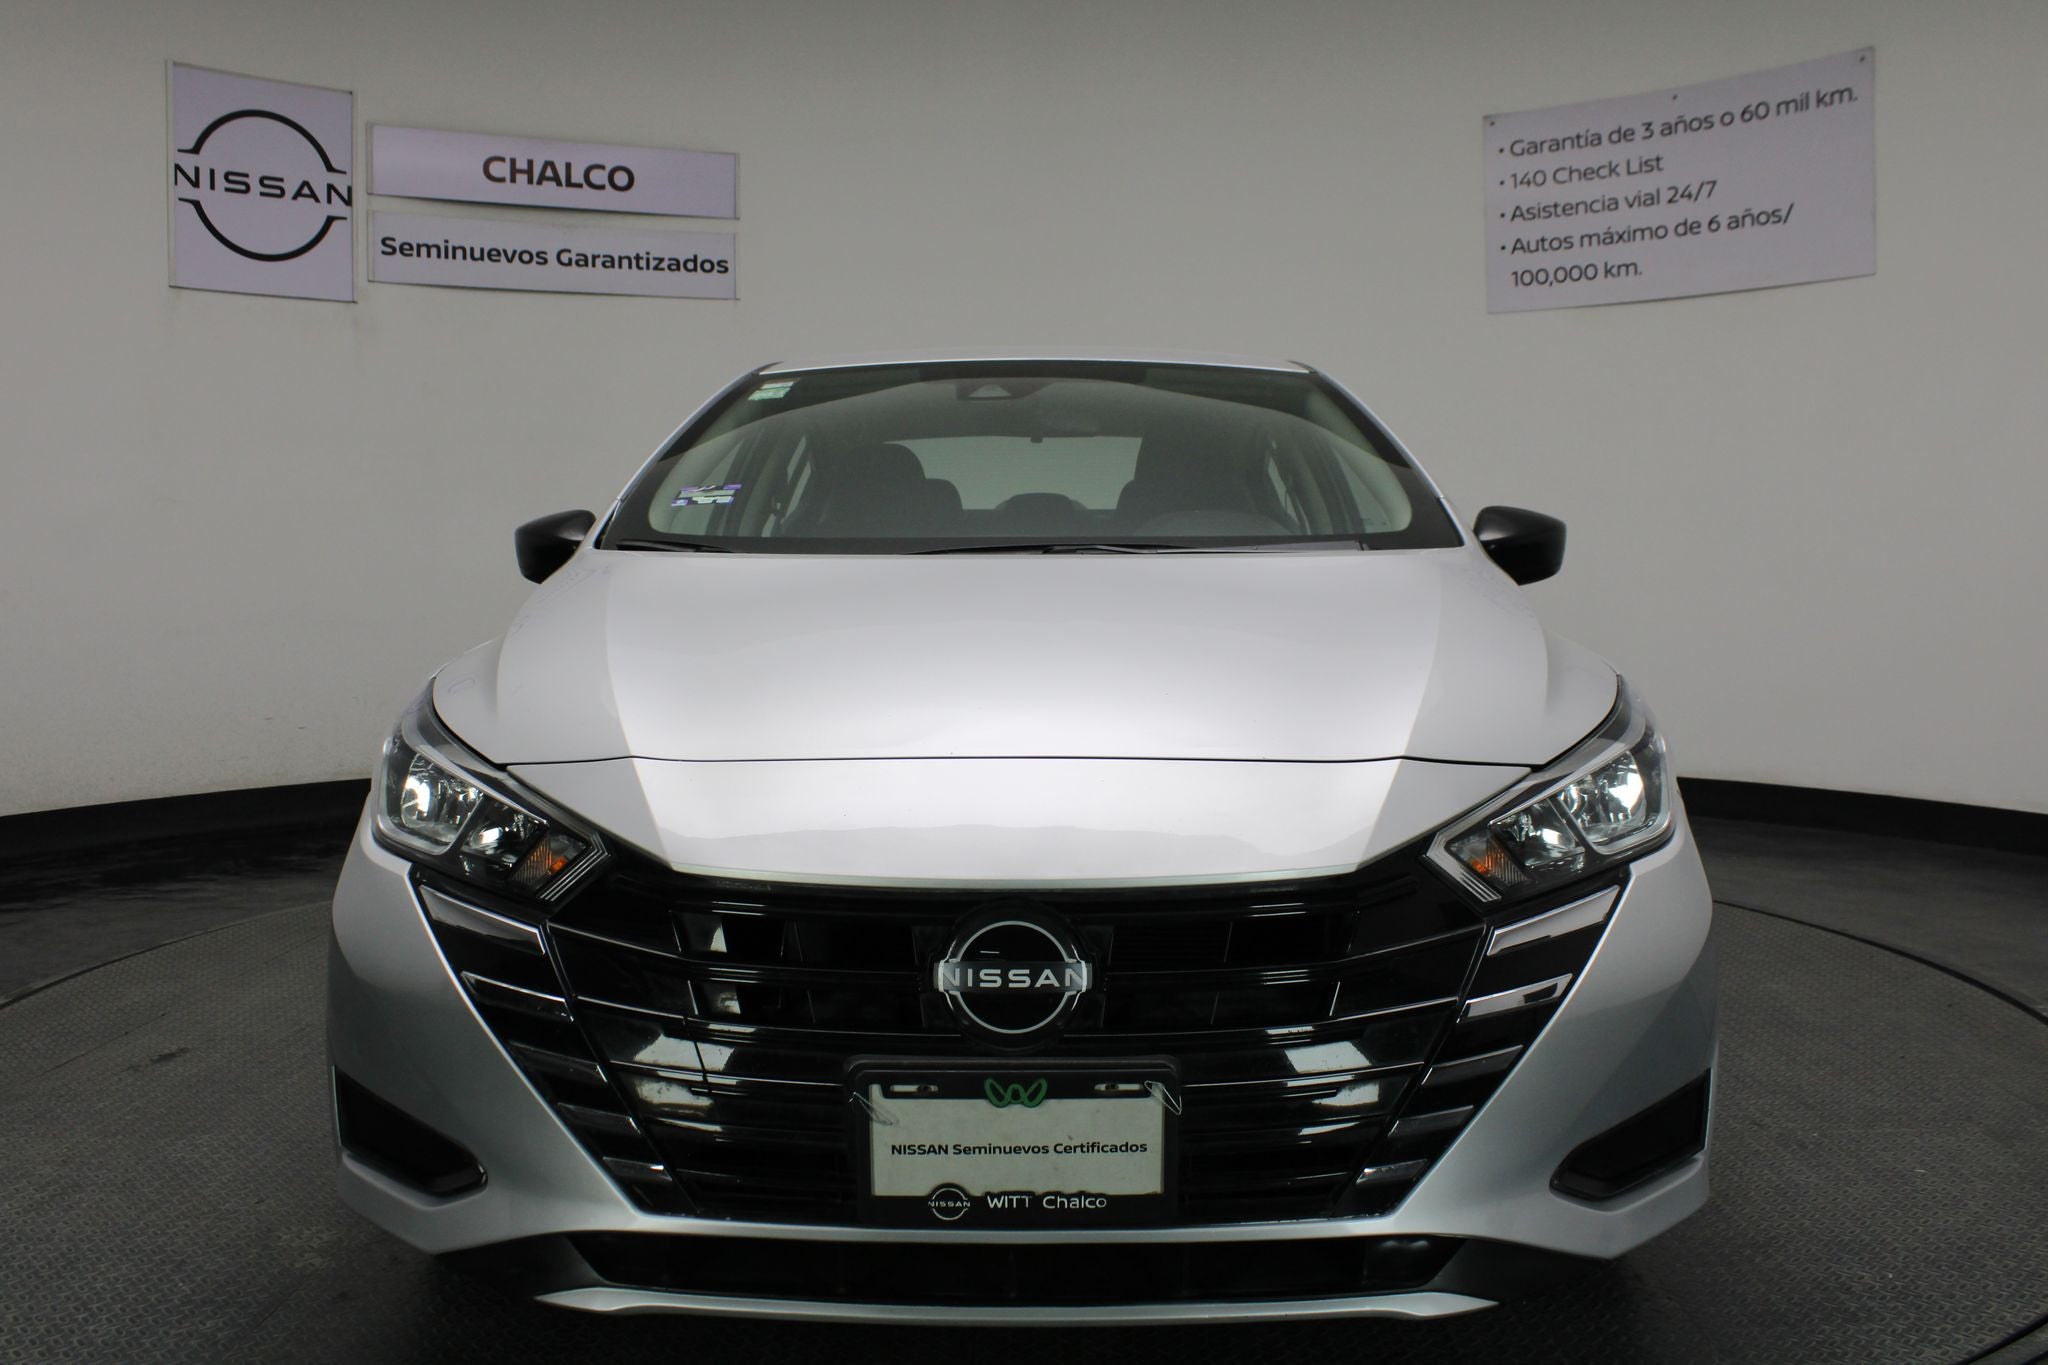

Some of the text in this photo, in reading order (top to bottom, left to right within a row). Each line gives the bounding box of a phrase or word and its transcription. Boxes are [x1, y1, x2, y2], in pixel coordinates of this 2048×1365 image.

[1509, 85, 1859, 157] Garantía de 3 años o 60 mil km.
[174, 162, 353, 208] NISSAN
[482, 155, 635, 193] CHALCO
[1511, 155, 1664, 189] 140 Check List
[1510, 179, 1718, 222] Asistencia vial 24/7
[1511, 202, 1795, 255] Autos máximo de 6 años/
[380, 236, 729, 274] Seminuevos Garantizados
[1511, 260, 1643, 287] 100,000 km.
[941, 968, 1086, 988] NISSAN
[891, 1141, 1148, 1156] NISSAN Seminuevos Certificados
[928, 1200, 971, 1208] NISSAN
[986, 1194, 1107, 1209] WITT Chalco
